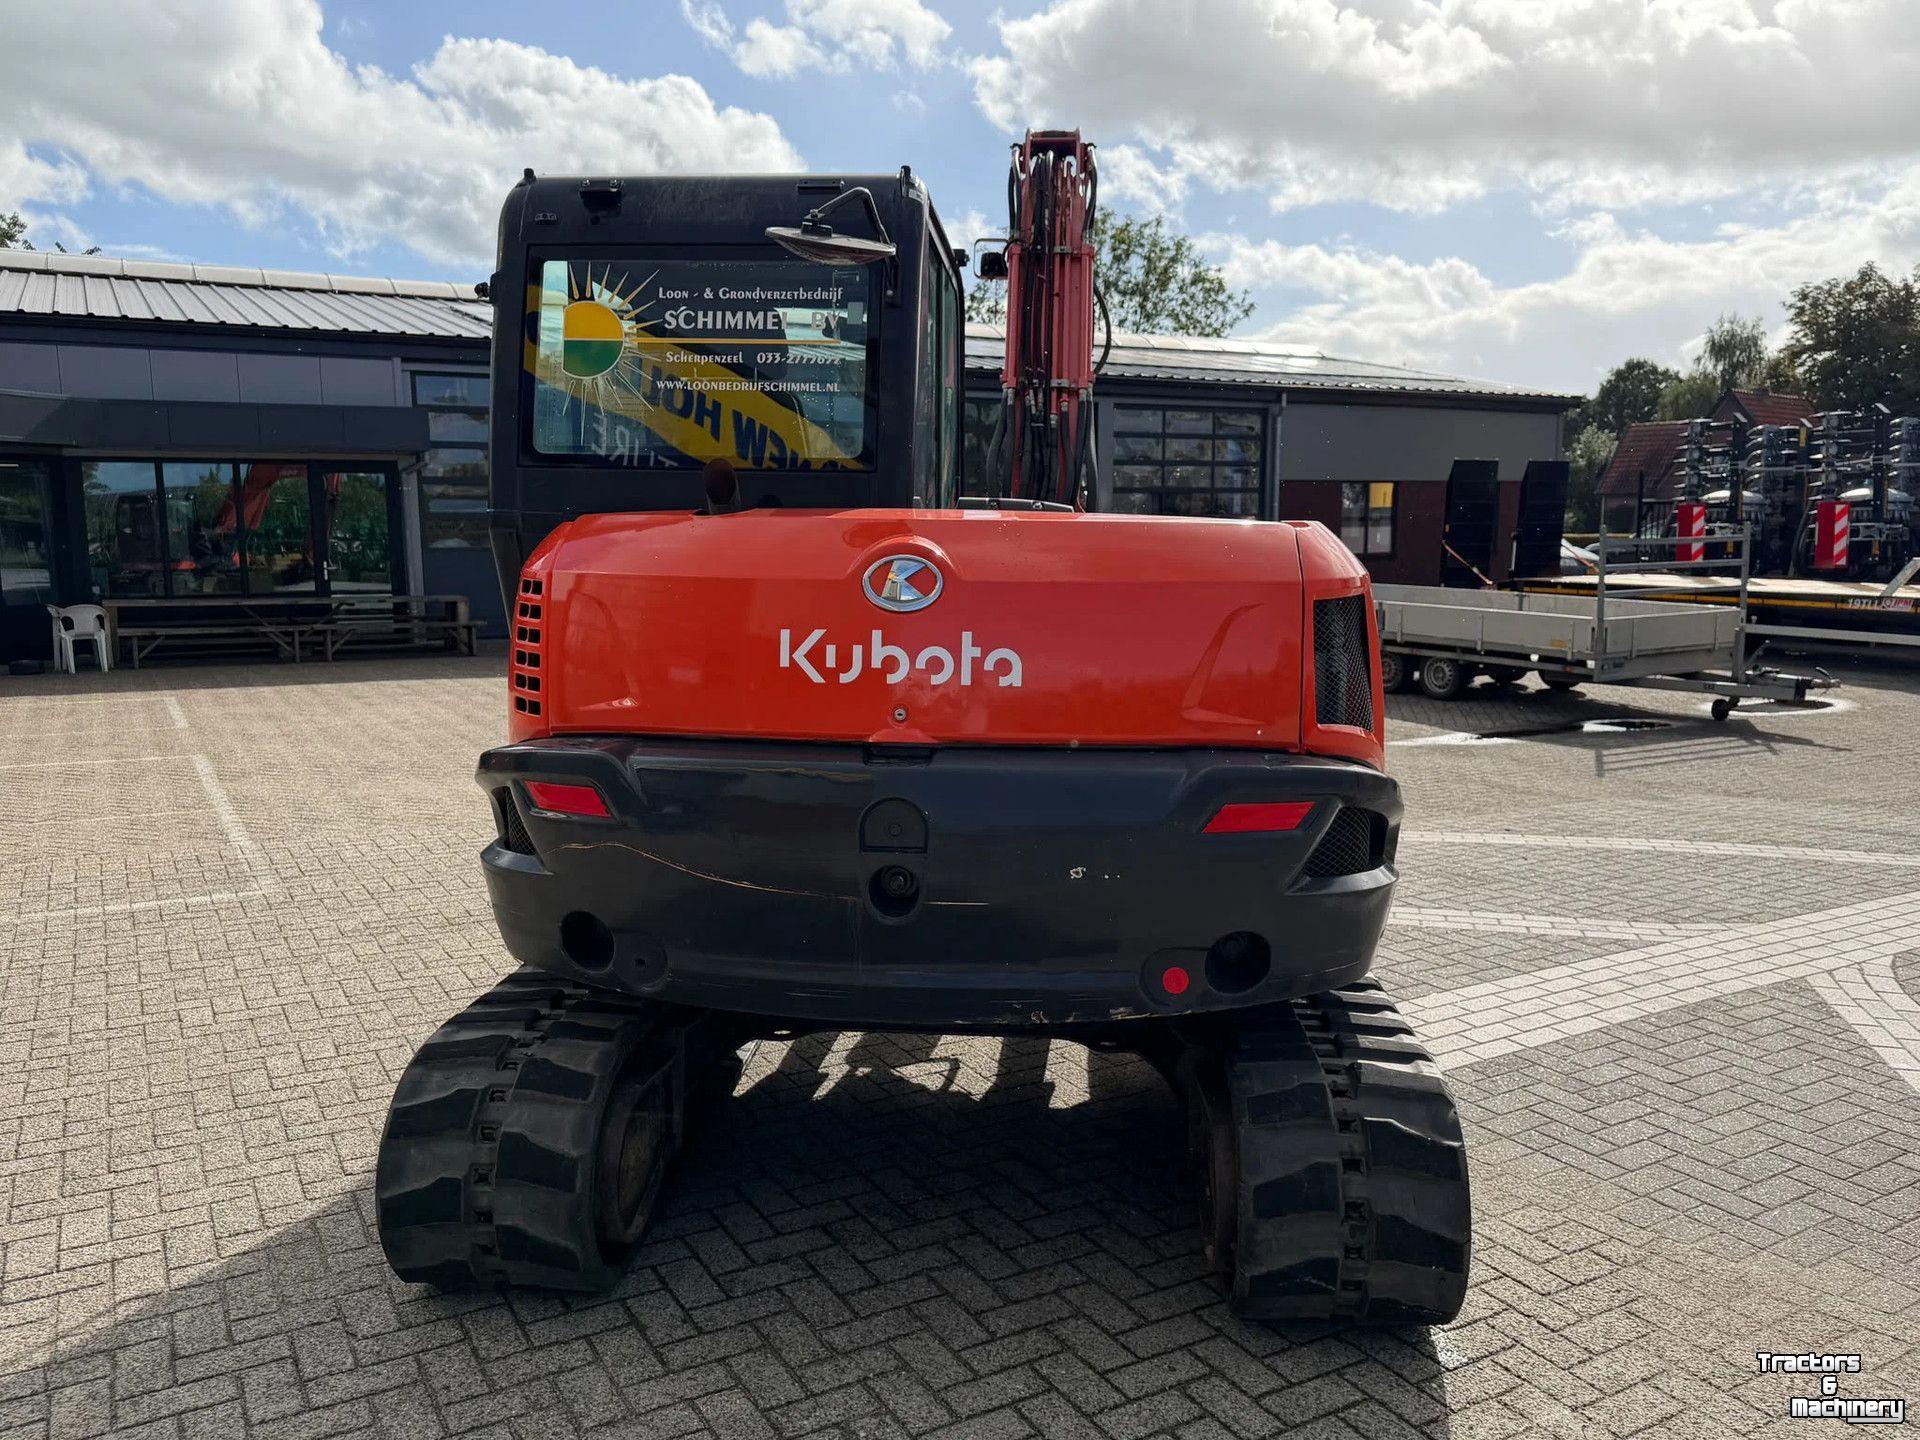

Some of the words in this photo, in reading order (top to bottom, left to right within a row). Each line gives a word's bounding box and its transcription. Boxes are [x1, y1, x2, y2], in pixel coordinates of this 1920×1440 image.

[703, 286, 714, 299] &
[811, 311, 840, 331] BV
[779, 628, 1023, 687] Kubota
